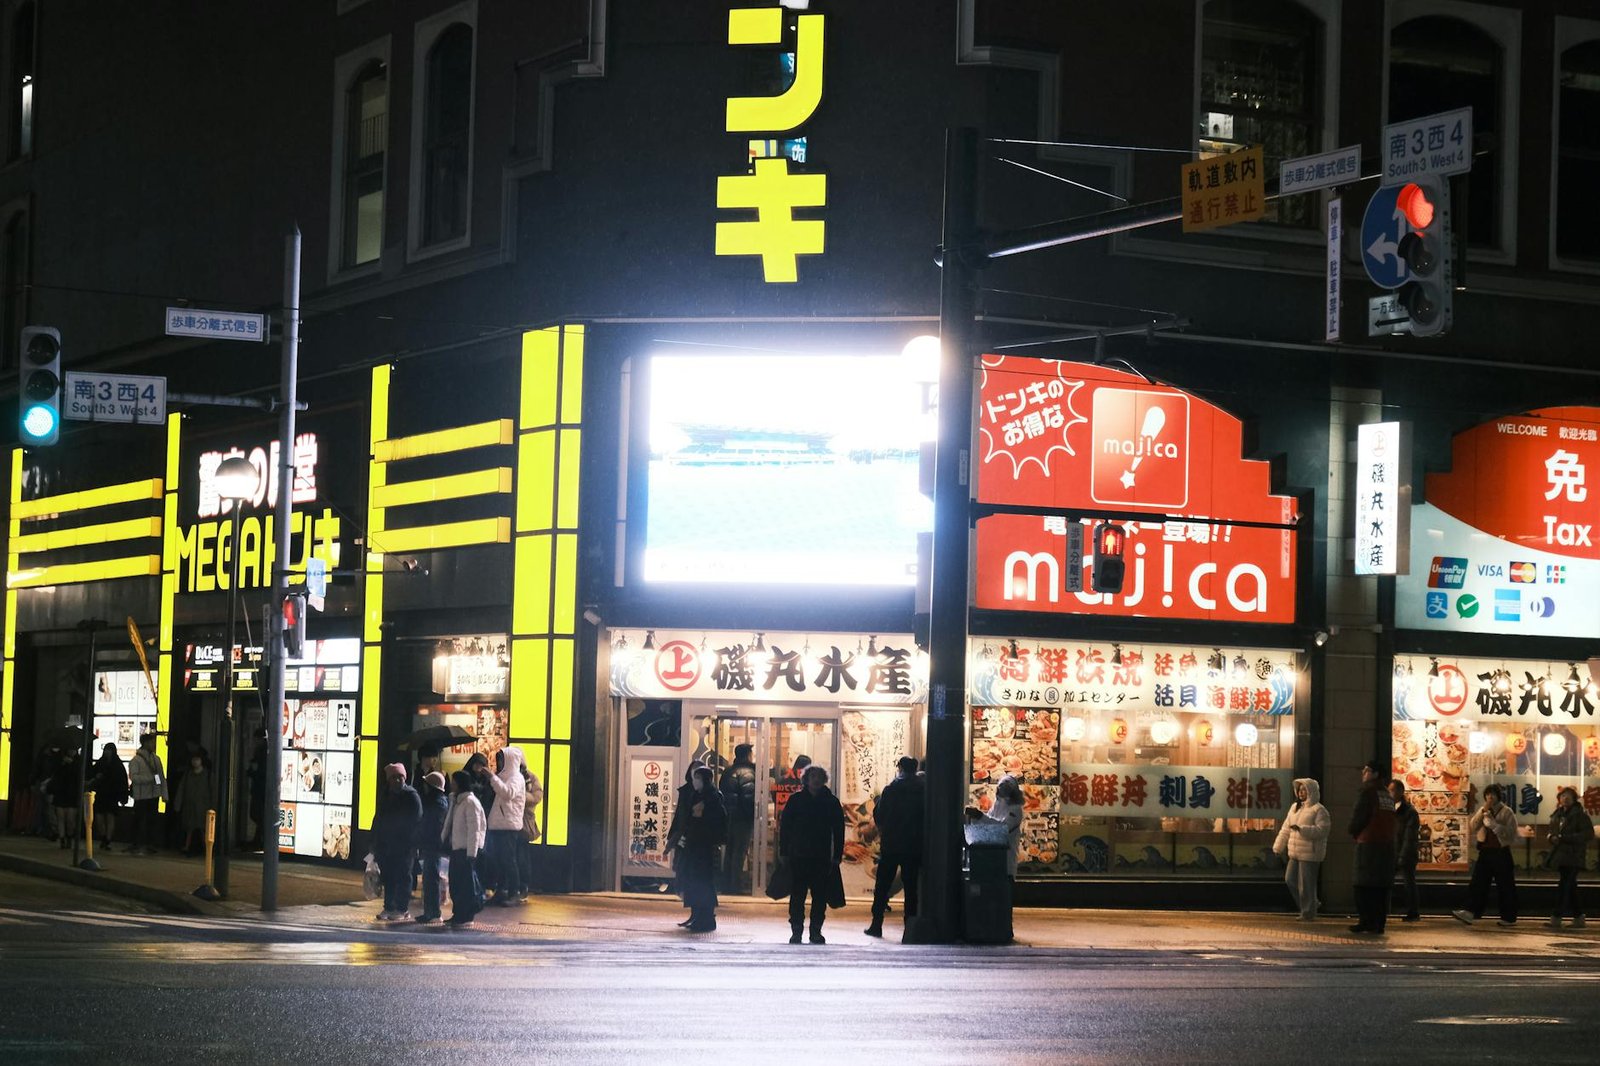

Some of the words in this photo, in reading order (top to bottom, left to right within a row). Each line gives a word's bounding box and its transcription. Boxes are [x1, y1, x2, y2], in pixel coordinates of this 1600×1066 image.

[1188, 156, 1256, 192] 軌道敷内
[1284, 156, 1357, 186] 歩車分離式信号
[1189, 189, 1257, 225] 通行禁止
[171, 316, 258, 334] 歩車分離式信号
[73, 379, 157, 403] 南3西4
[986, 380, 1064, 423] ドンキの
[1002, 404, 1065, 447] お得な
[1497, 423, 1548, 437] WELCOME
[1544, 449, 1588, 503] 免
[1369, 462, 1385, 567] 磯丸水産
[1543, 515, 1593, 547] Tax
[1431, 563, 1466, 578] UnionPay
[1477, 564, 1503, 577] VISA
[711, 643, 912, 695] 磯丸水産
[1207, 685, 1272, 711] 海鮮丼
[1061, 772, 1148, 808] 海鮮丼
[1159, 775, 1215, 809] 刺身
[1226, 776, 1282, 811] 活魚
[643, 782, 660, 851] 磯丸水産
